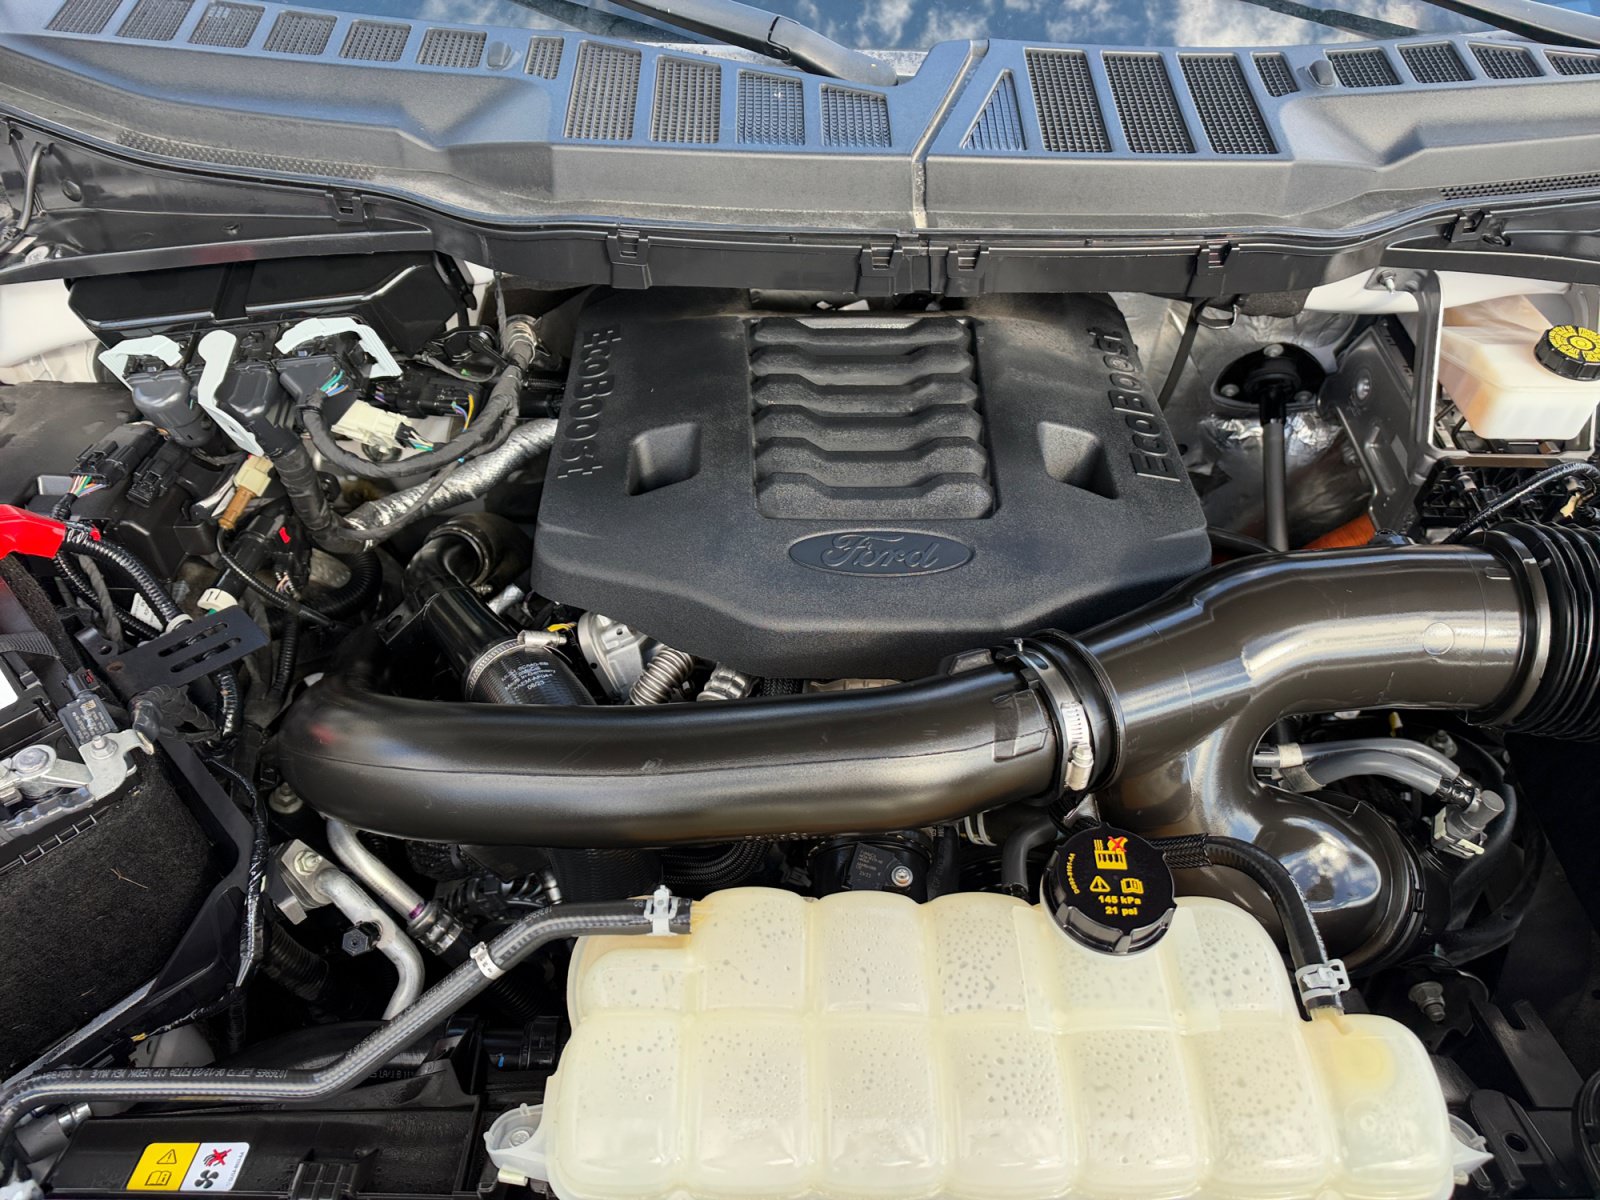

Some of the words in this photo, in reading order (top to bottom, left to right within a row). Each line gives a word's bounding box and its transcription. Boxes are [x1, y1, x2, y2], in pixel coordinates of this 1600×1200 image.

[555, 330, 622, 479] EcoBoost
[1088, 329, 1181, 482] EcoBoost
[820, 534, 940, 569] Ford
[1098, 894, 1119, 905] 145
[1120, 895, 1142, 906] kPa
[1104, 906, 1119, 915] 21
[1121, 907, 1138, 917] psi
